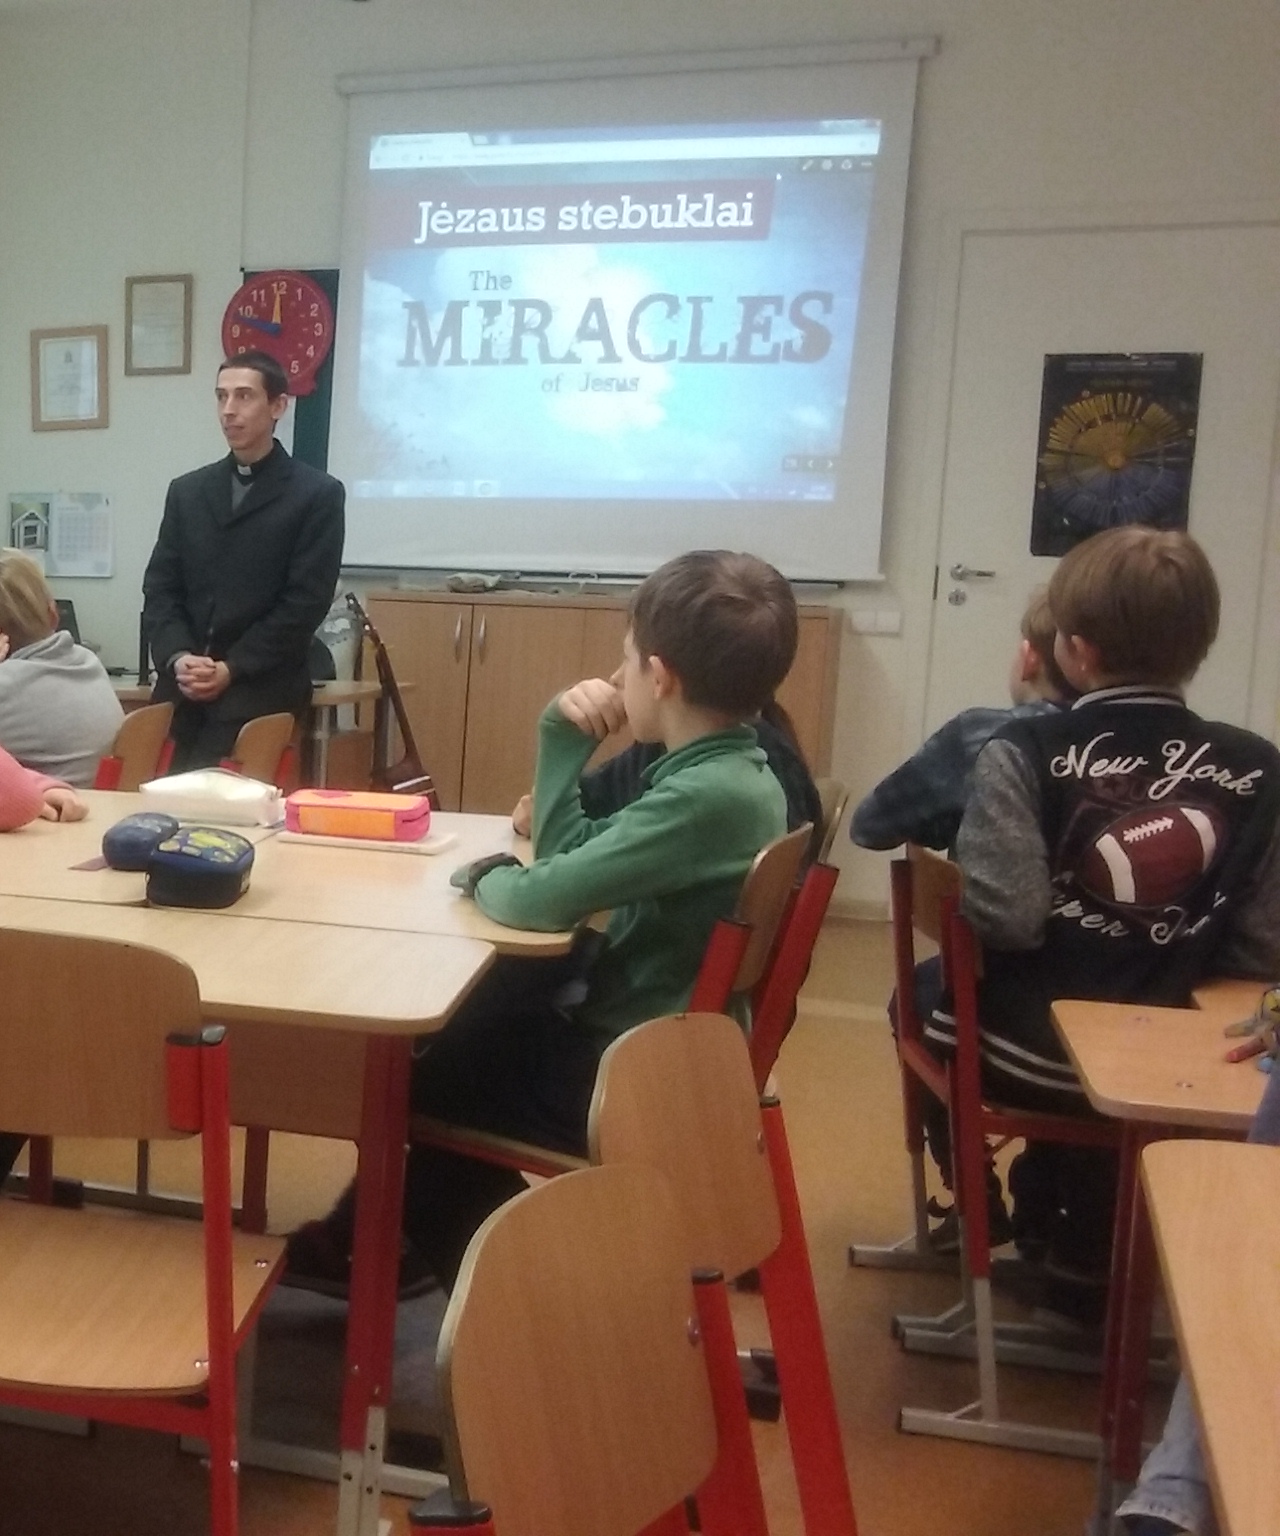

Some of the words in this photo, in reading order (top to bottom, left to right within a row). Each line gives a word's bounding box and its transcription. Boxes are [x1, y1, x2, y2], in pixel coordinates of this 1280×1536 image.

[415, 201, 546, 244] Jėzaus
[557, 192, 754, 232] stebuklai
[470, 270, 513, 291] The
[271, 281, 287, 295] 12
[296, 288, 303, 301] 1
[251, 289, 266, 302] 11
[238, 305, 253, 318] 10
[310, 303, 319, 317] 2
[231, 324, 241, 338] 9
[314, 323, 323, 336] 3
[397, 291, 834, 366] MIRACLES
[306, 345, 315, 358] 4
[290, 360, 300, 374] 5
[541, 372, 564, 392] of
[579, 372, 640, 392] Jesus
[1050, 732, 1148, 779] New
[1148, 739, 1263, 800] York
